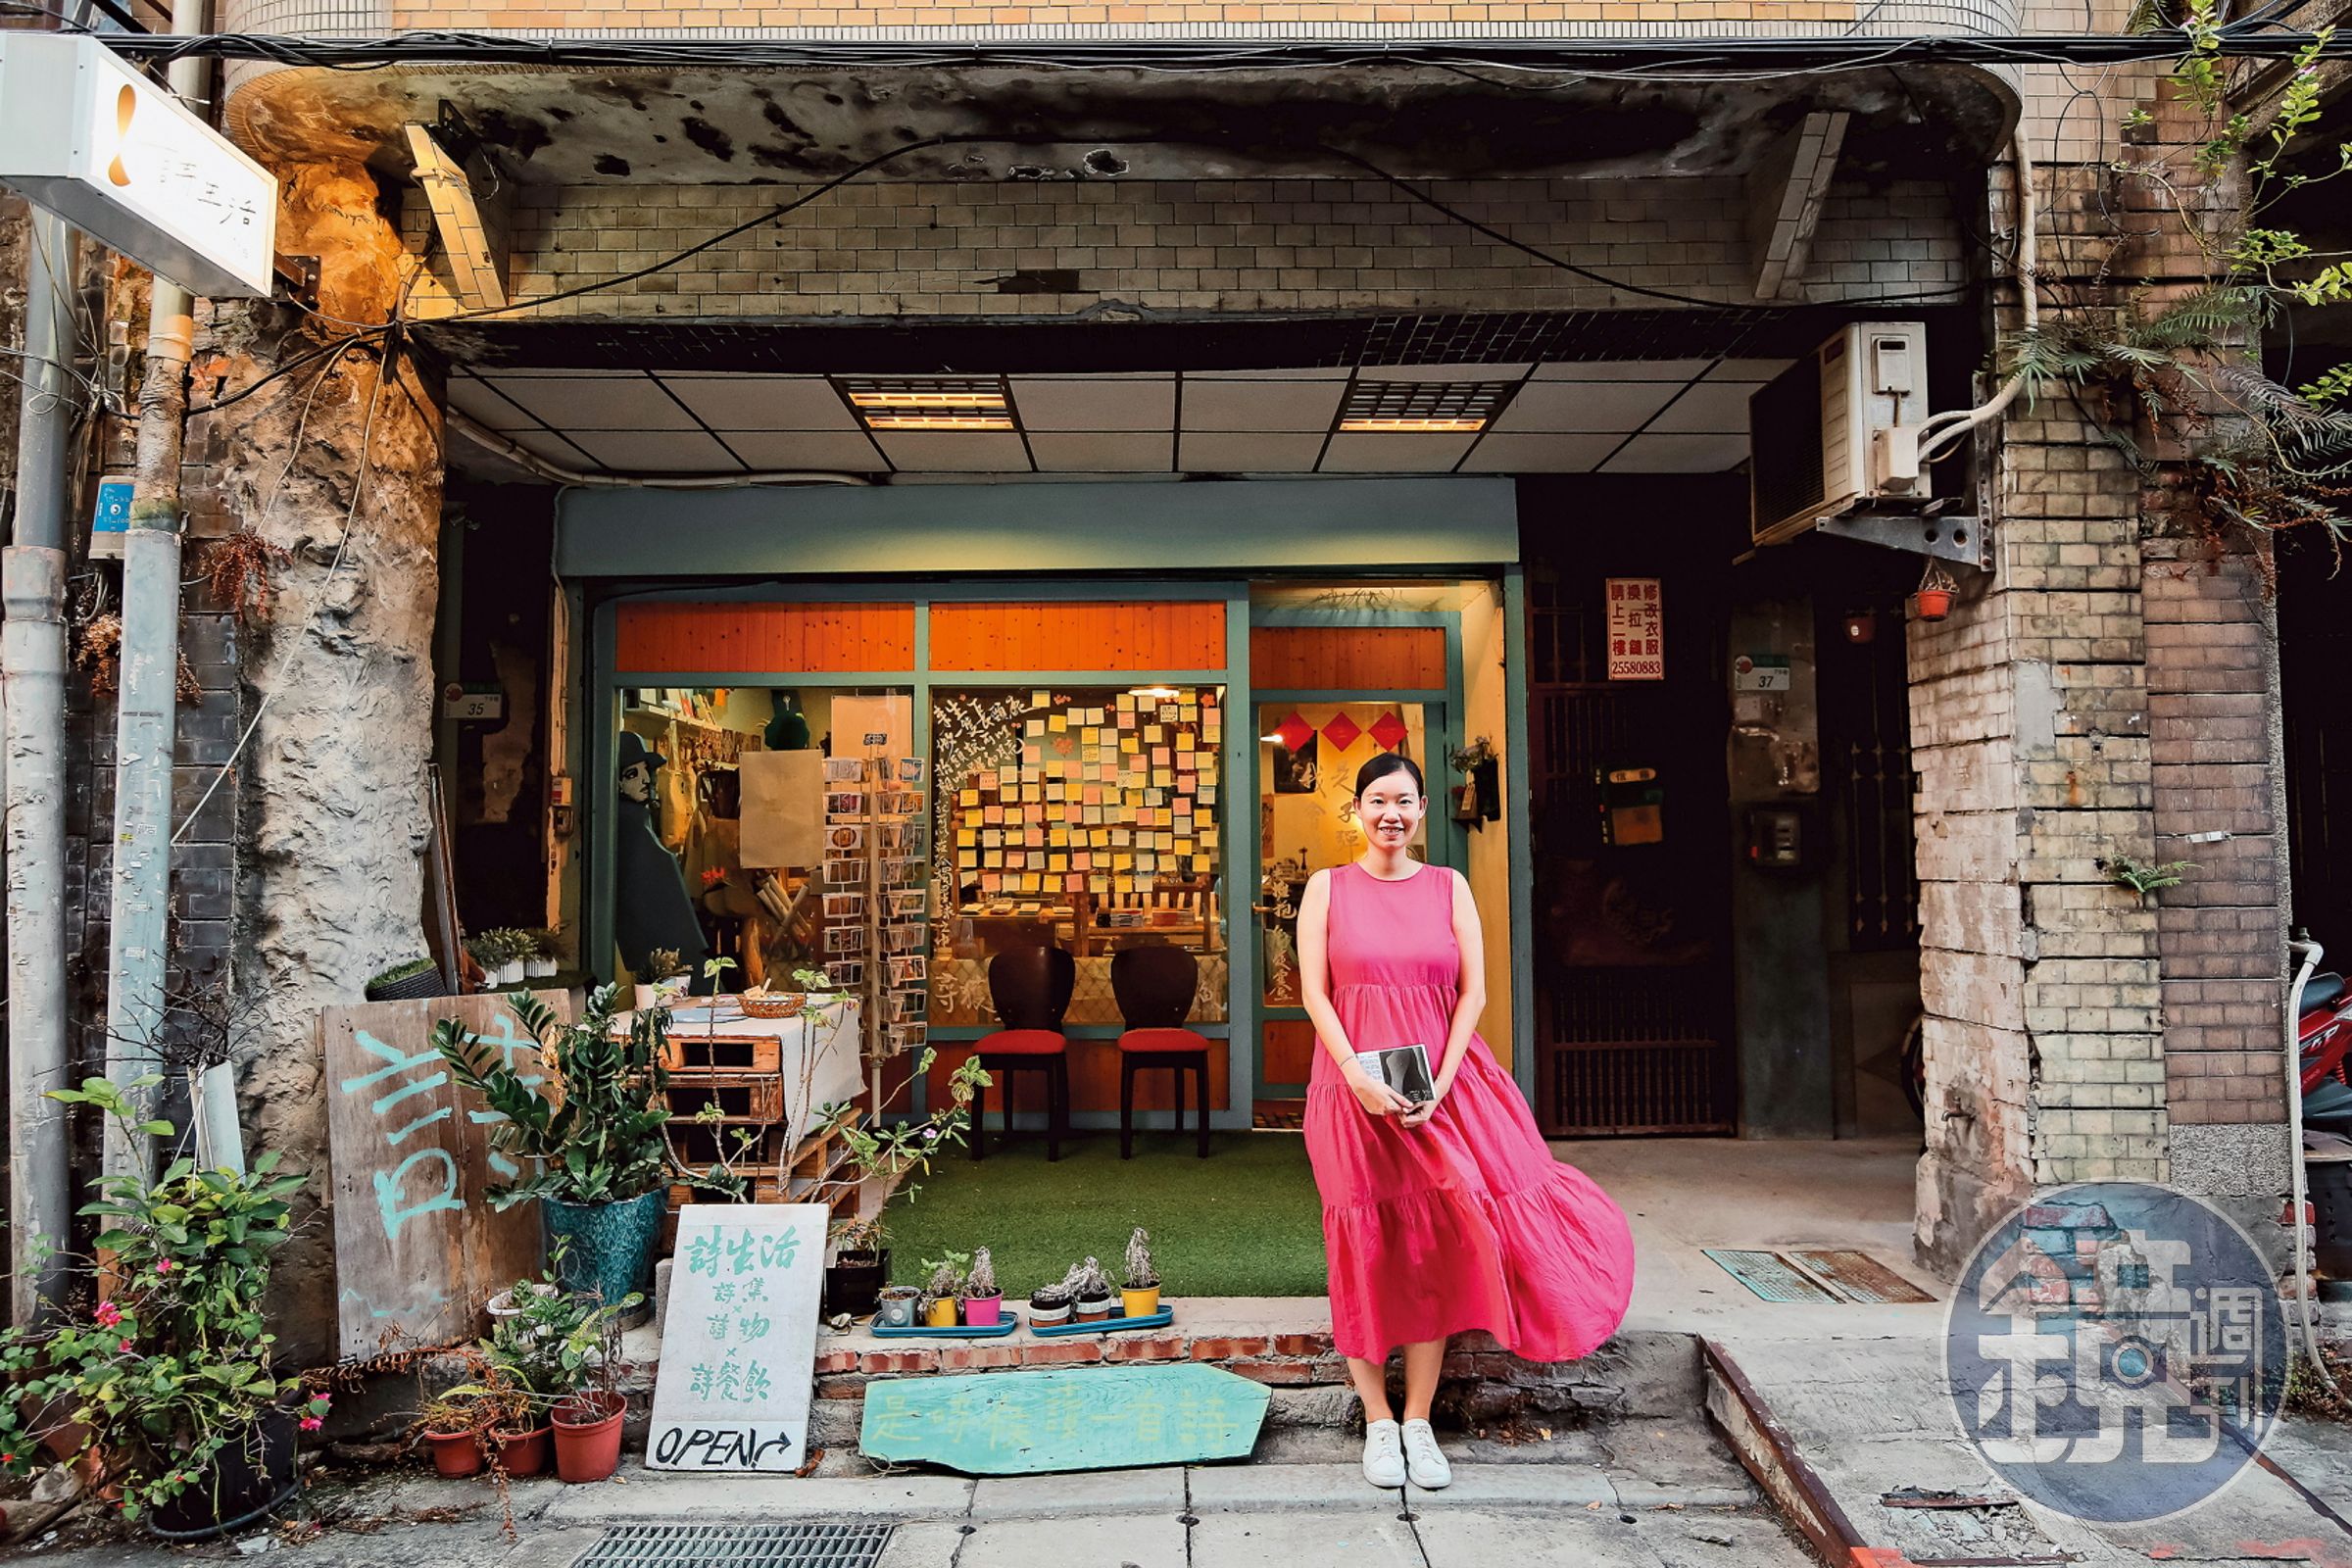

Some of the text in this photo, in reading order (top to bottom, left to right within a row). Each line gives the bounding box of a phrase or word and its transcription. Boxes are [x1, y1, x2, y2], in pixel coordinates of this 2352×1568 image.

[1610, 584, 1626, 656] 請上二樓
[1643, 584, 1659, 656] 修改衣服
[1612, 661, 1660, 674] 25580883
[1758, 675, 1774, 688] 37
[467, 703, 485, 716] 35
[683, 1224, 802, 1279] 詩生活
[690, 1359, 771, 1402] 詩餐飲
[870, 1381, 1240, 1451] 是時候讀一首詩
